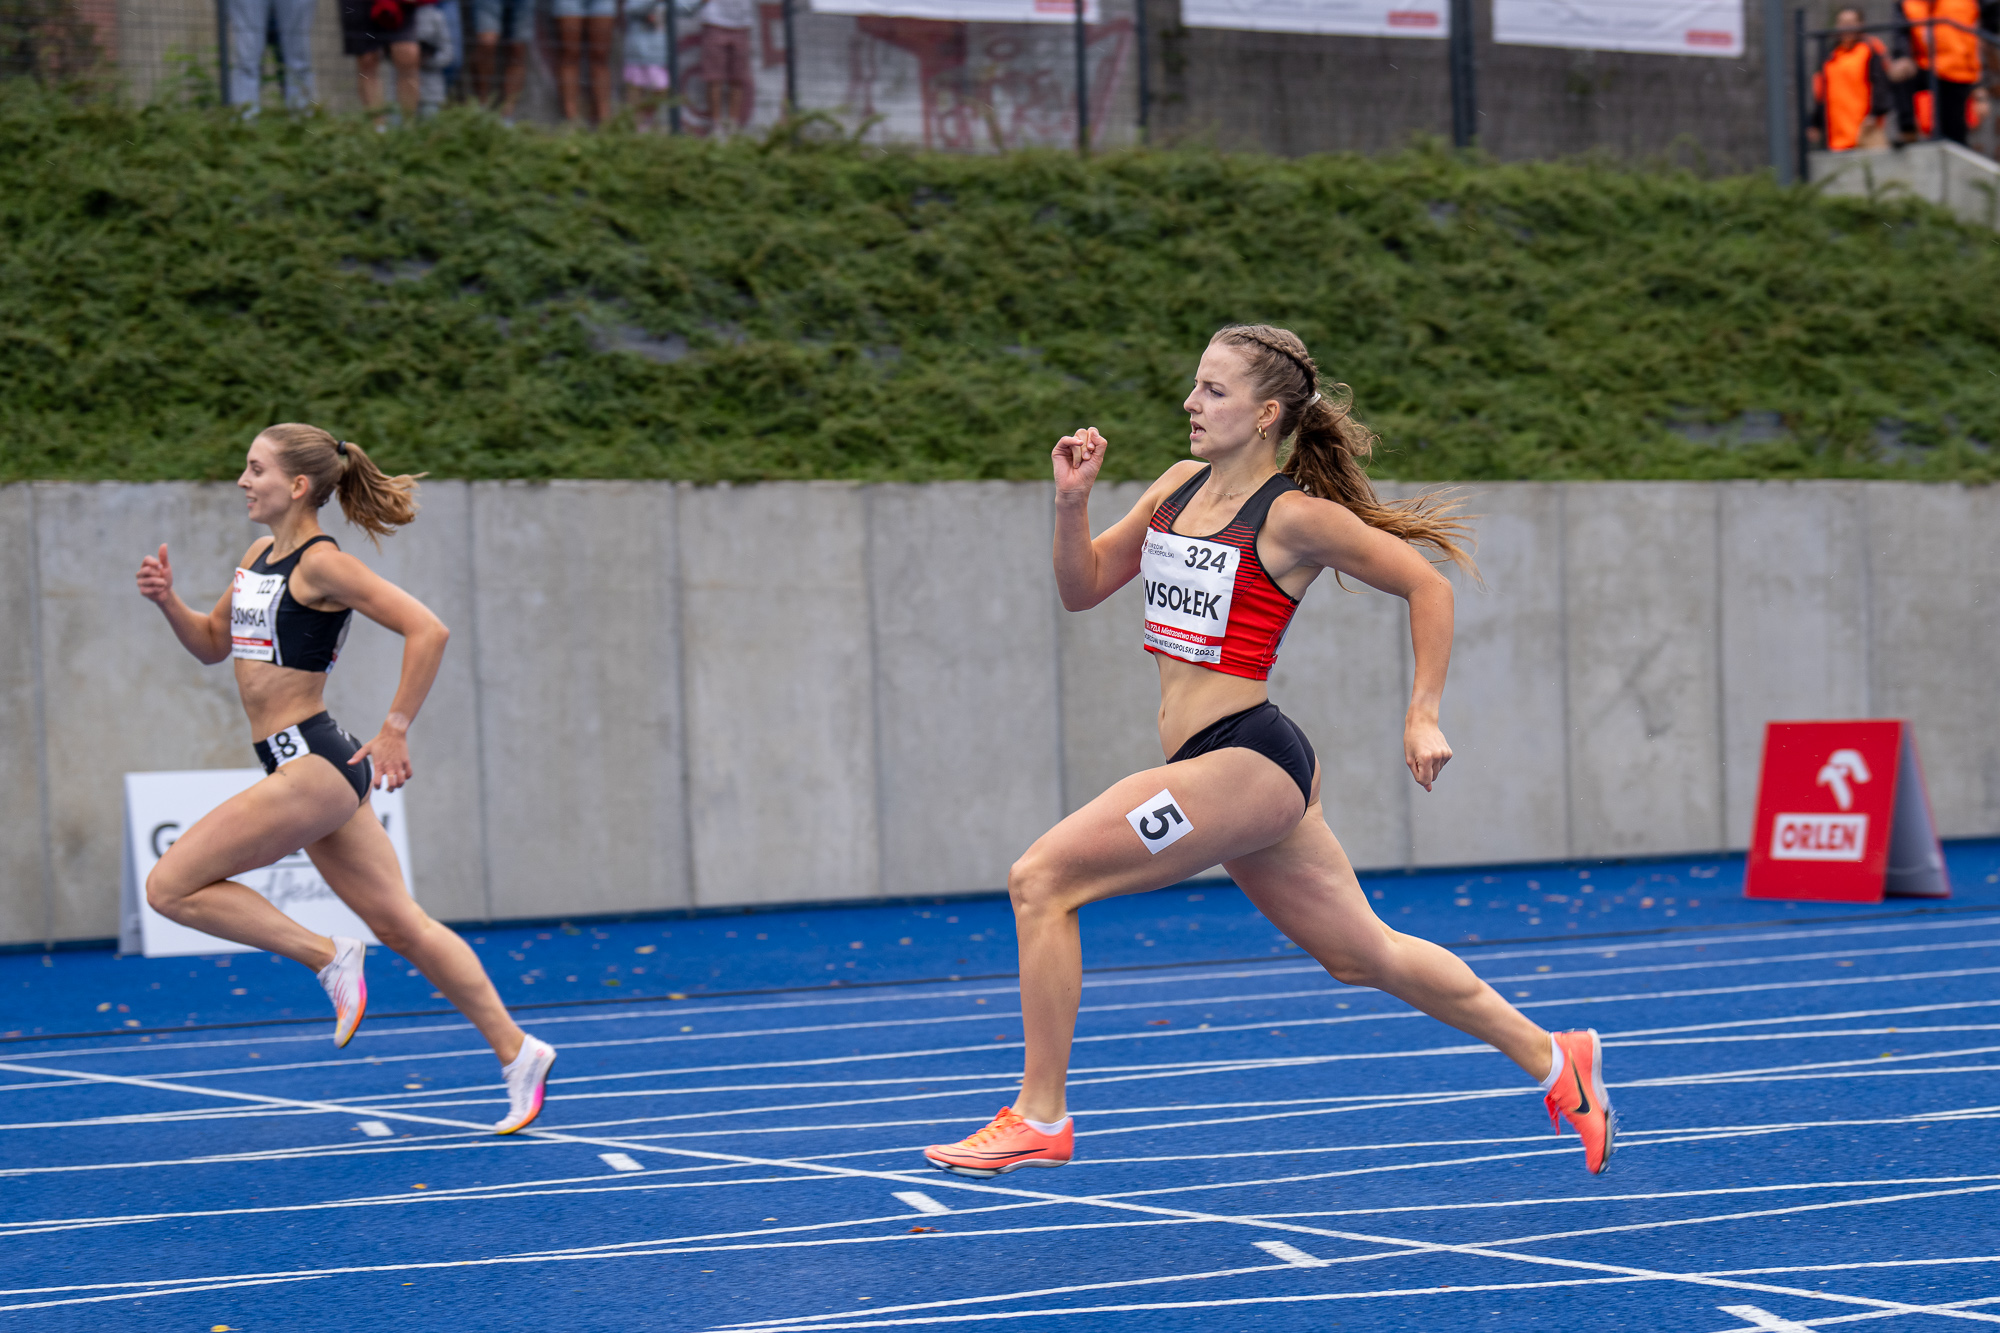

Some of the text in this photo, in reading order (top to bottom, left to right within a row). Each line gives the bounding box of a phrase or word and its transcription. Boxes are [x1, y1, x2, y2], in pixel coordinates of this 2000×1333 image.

[1184, 545, 1228, 574] 324
[1144, 632, 1215, 656] ORZÓW WIELKOPOLSKI 2023
[1160, 626, 1190, 640] Mistrzostwa
[1189, 633, 1207, 644] Polski
[274, 731, 298, 758] 8
[1139, 803, 1184, 841] 5
[1781, 822, 1859, 851] ORLEN
